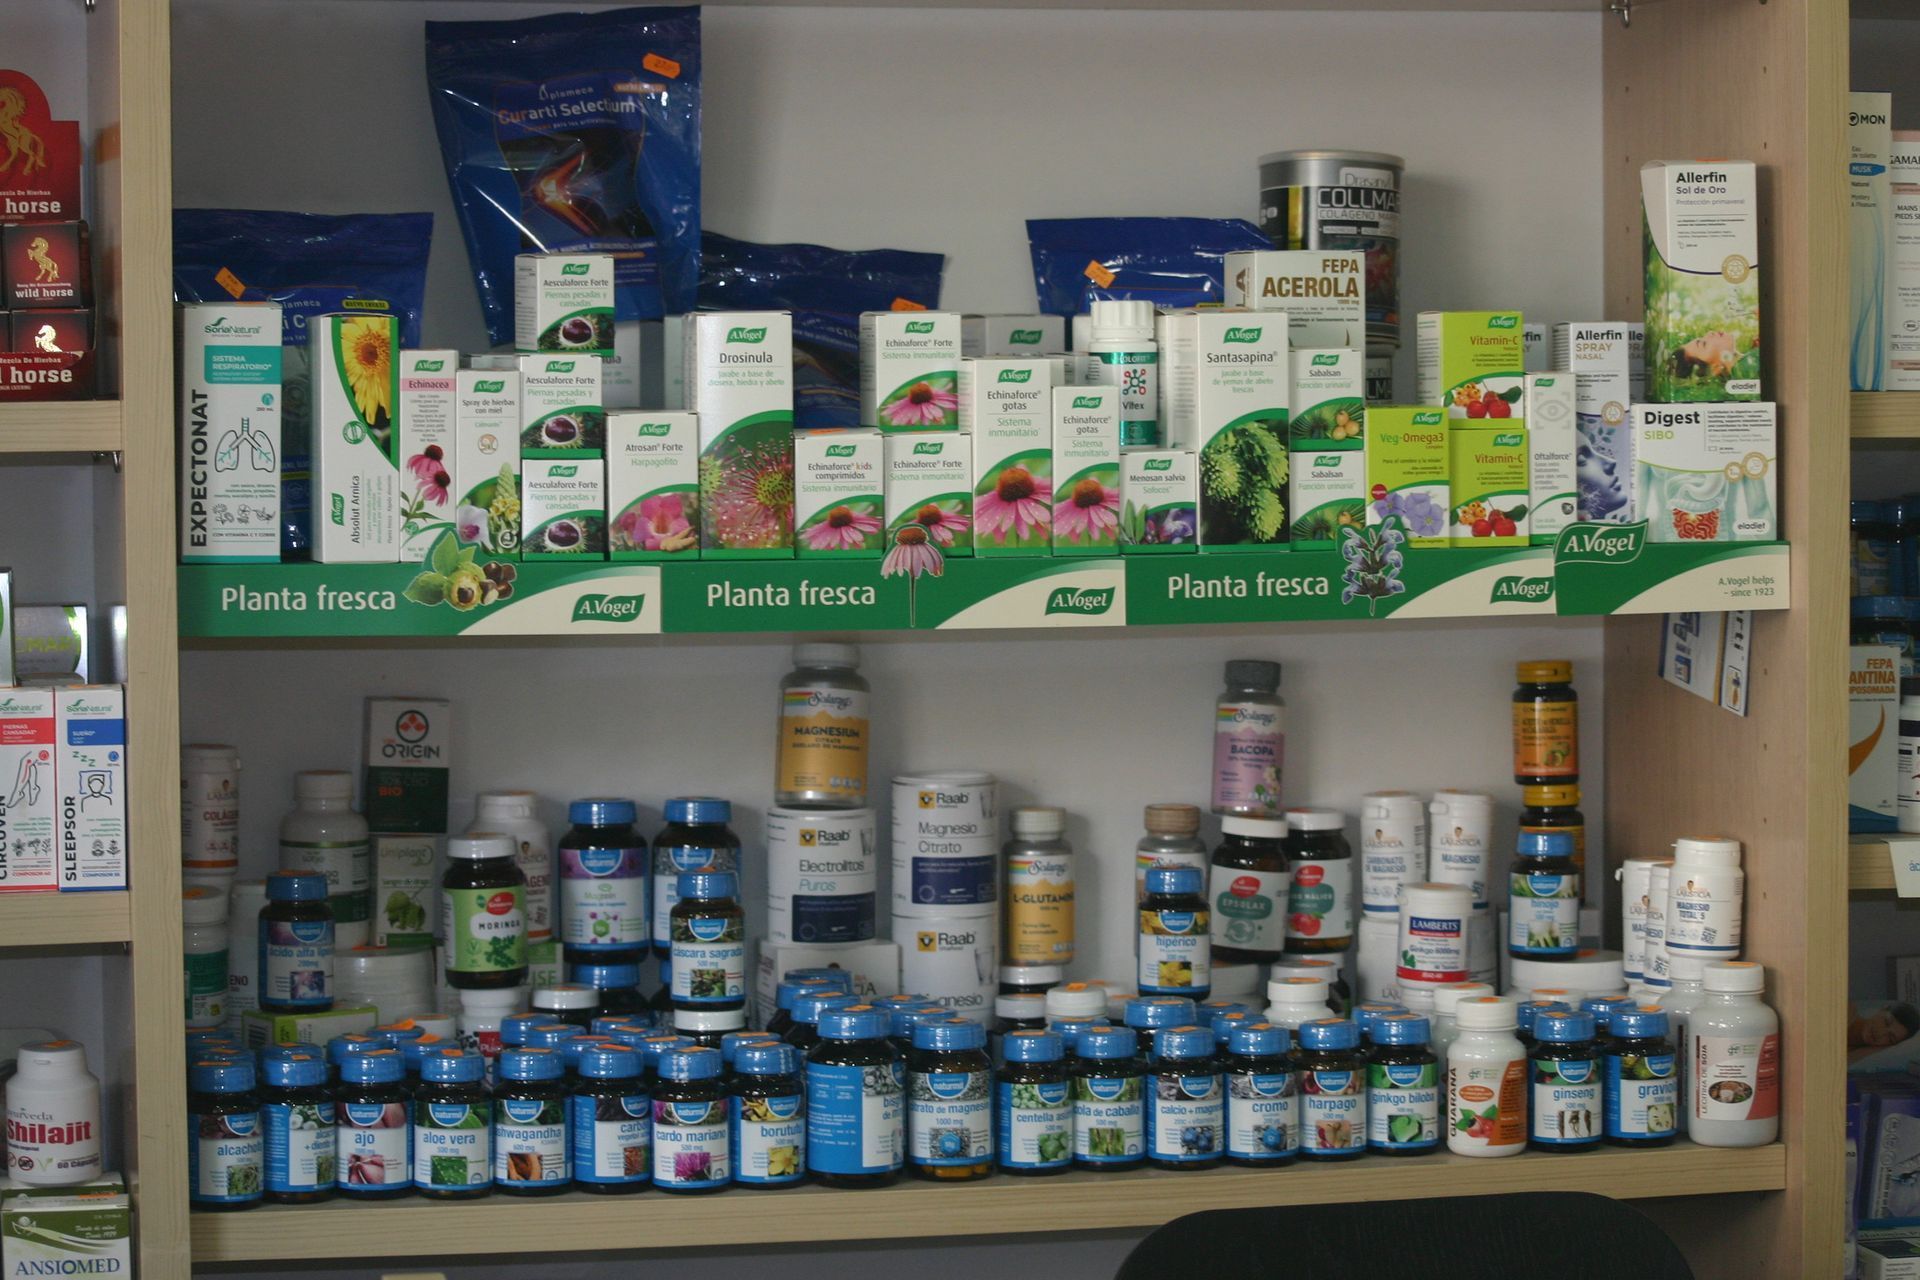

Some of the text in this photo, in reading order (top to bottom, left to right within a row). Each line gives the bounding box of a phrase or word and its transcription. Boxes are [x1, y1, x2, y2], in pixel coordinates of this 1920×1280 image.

[1860, 114, 1886, 125] MON
[1675, 172, 1727, 184] Allerfin
[1675, 186, 1727, 194] Sol de Oro
[6, 198, 62, 214] horse
[1322, 259, 1360, 273] FEPA
[15, 287, 40, 298] wild
[42, 287, 74, 298] horse
[1262, 277, 1360, 298] ACEROLA
[729, 329, 764, 342] A.Vogel
[1226, 329, 1259, 341] A.Vogel
[1575, 330, 1624, 341] Allerfin
[933, 339, 954, 347] Forte
[1470, 336, 1518, 346] Vitamin-C
[1575, 343, 1613, 352] SPRAY
[718, 352, 774, 364] Drosinula
[10, 368, 73, 385] horse
[1000, 371, 1030, 382] A.Vogel
[1308, 369, 1342, 378] Sabalsan
[408, 380, 449, 389] Echinacea
[525, 376, 596, 385] Aesculaforce Forte
[462, 399, 481, 408] Spray
[1002, 401, 1028, 411] gotas
[1121, 401, 1145, 410] Vitex
[996, 417, 1032, 427] Sistema
[1643, 410, 1701, 426] Digest
[1076, 426, 1099, 435] gotas
[1643, 430, 1675, 440] SIBO
[1071, 439, 1103, 448] Sistema
[1380, 432, 1444, 445] Veg-Omega3
[662, 442, 684, 451] Forte
[1474, 453, 1523, 464] Vitamin-C
[190, 389, 209, 548] EXPECTONAT
[942, 460, 963, 469] Forte
[815, 470, 866, 480] comprimidos
[1129, 473, 1186, 482] Menosan salvia
[1311, 470, 1344, 480] Sabalsan
[527, 480, 599, 489] Aesculaforce Forte
[351, 474, 361, 544] Absolut Arnica
[1737, 520, 1766, 531] eladiet
[1564, 529, 1637, 555] A.Vogel
[1167, 571, 1329, 600] Planta fresca
[1718, 576, 1774, 587] A.Vogel helps
[707, 579, 876, 607] Planta fresca
[1496, 580, 1549, 598] A.Vogel
[1730, 587, 1774, 596] since 1923
[221, 583, 397, 611] Planta fresca
[1052, 592, 1107, 610] A.Vogel
[578, 598, 636, 617] A.Vogel
[1866, 658, 1894, 669] FEPA
[794, 726, 860, 738] MAGNESIUM
[382, 743, 440, 759] ORIGIN
[1229, 746, 1274, 757] BACOPA
[936, 792, 970, 804] Raab
[918, 822, 979, 836] Magnesio
[65, 796, 77, 881] SLEEPSOR
[817, 829, 851, 841] Raab
[918, 841, 963, 853] Citrato
[1441, 854, 1481, 865] MAGNESIO
[799, 860, 865, 873] Electrolitos
[798, 878, 837, 891] Puros
[1676, 901, 1710, 912] MAGNESIO
[478, 920, 520, 931] MORINGA
[1412, 920, 1460, 930] LAMBERTS
[938, 931, 977, 945] Raab
[1371, 1091, 1435, 1106] ginkgo biloba
[1552, 1087, 1595, 1101] ginseng
[1252, 1101, 1288, 1114] cromo
[1308, 1096, 1357, 1112] harpago
[1449, 1067, 1457, 1137] GUARANA
[939, 1104, 949, 1114] de
[1092, 1107, 1104, 1116] de
[1160, 1105, 1186, 1115] calcio
[935, 1117, 964, 1127] 1000 mg
[1016, 1112, 1055, 1123] centella
[7, 1121, 92, 1144] Shilajit
[423, 1132, 476, 1144] aloe vera
[655, 1128, 728, 1142] cardo mariano
[355, 1131, 376, 1147] ajo
[15, 1258, 121, 1276] ANSIOMED
